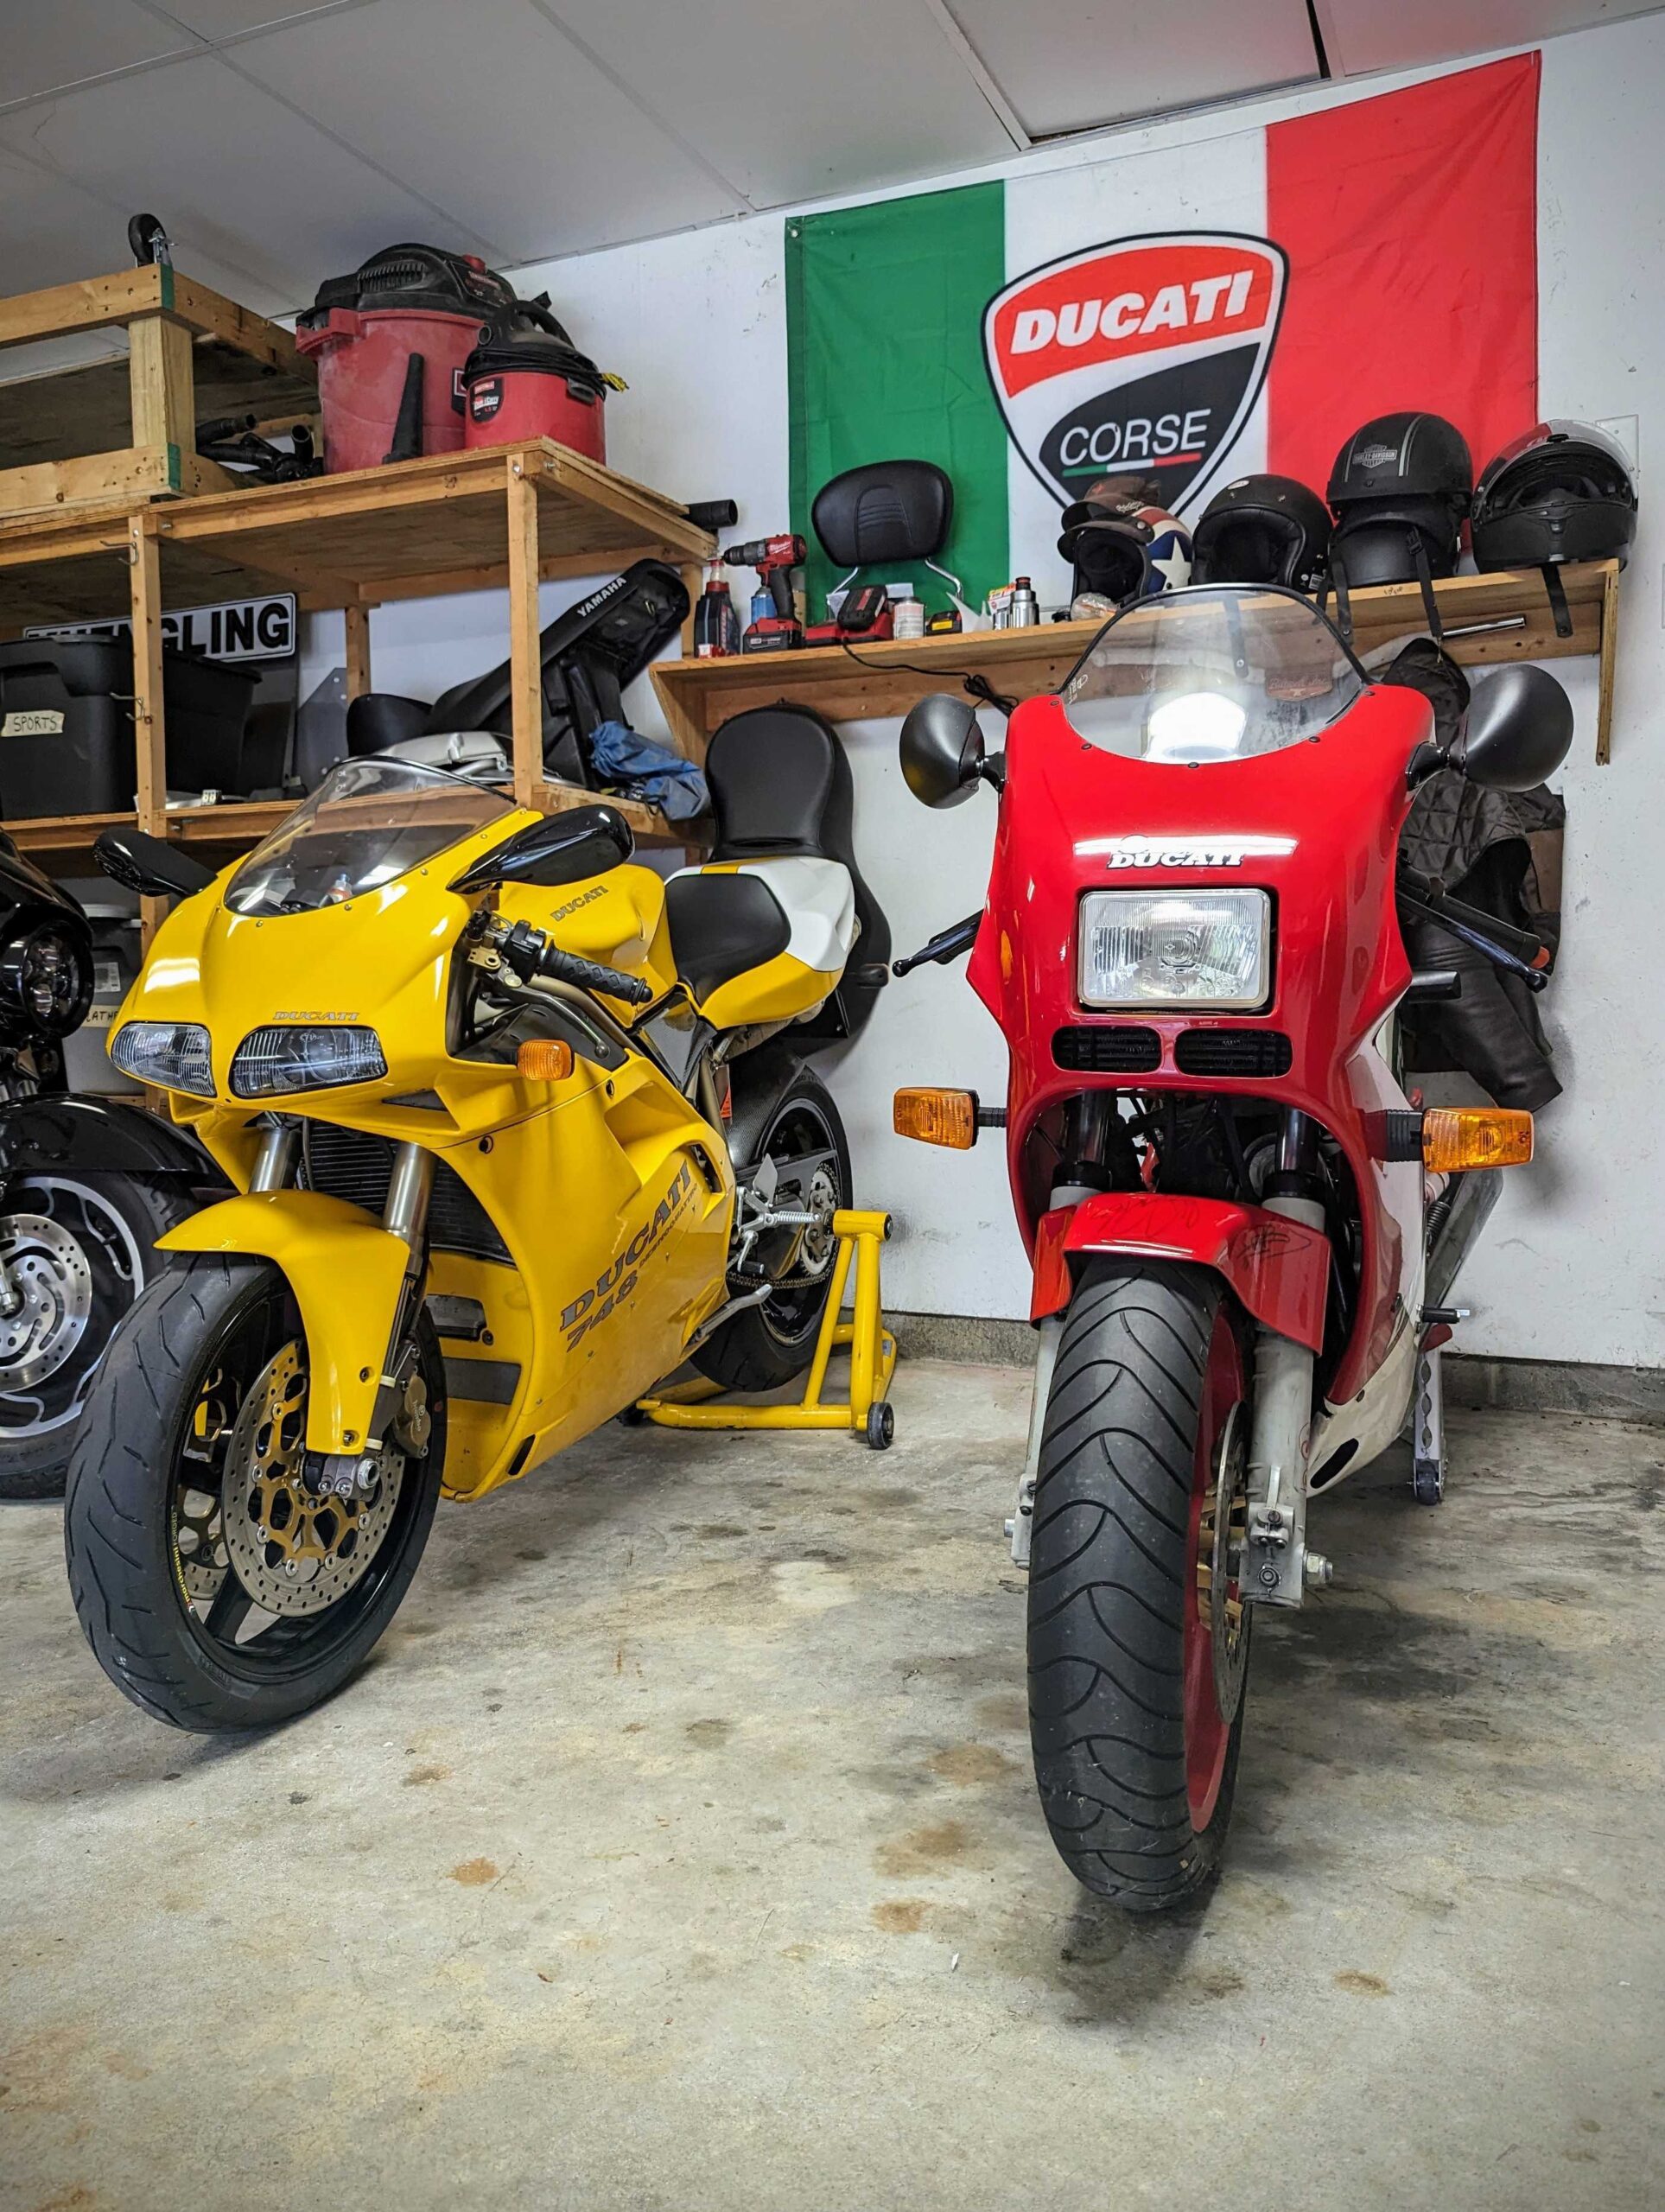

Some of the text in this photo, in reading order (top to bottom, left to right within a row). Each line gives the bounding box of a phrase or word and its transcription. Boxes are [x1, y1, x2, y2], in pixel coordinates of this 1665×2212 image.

[1009, 270, 1254, 354] DUCATI
[1059, 408, 1211, 466] CORSE
[577, 577, 627, 617] YAMAHA
[14, 715, 57, 732] SPORTS
[1107, 850, 1244, 870] DUCATI
[550, 885, 609, 922] DUCATI
[273, 1011, 359, 1021] DUCATI
[560, 1160, 691, 1332] DUCATI
[567, 1269, 638, 1353] 748
[173, 1545, 191, 1603] marchesini
